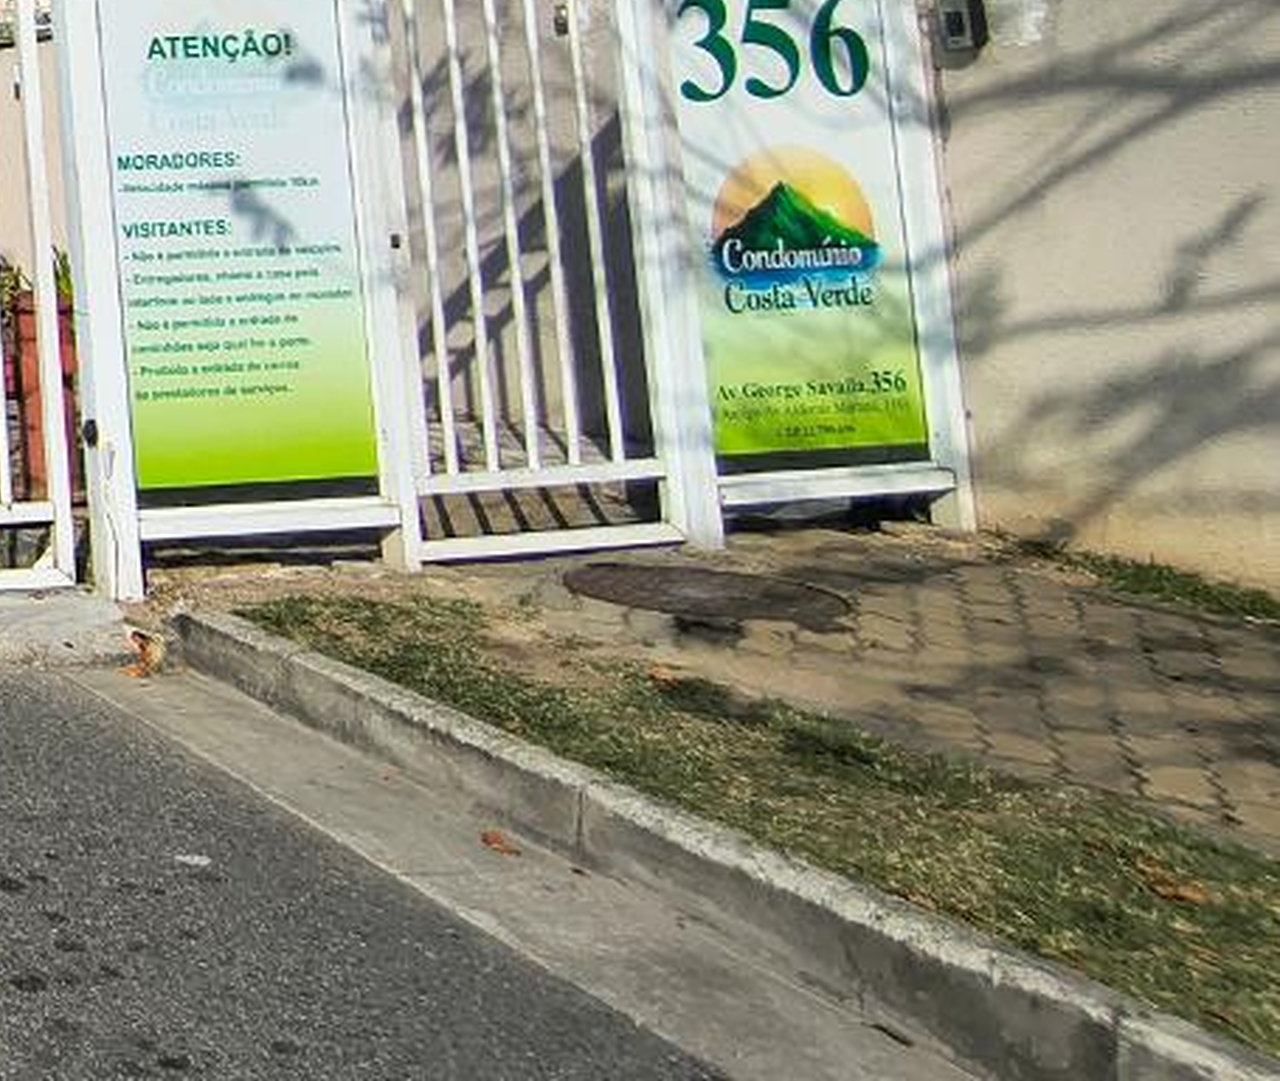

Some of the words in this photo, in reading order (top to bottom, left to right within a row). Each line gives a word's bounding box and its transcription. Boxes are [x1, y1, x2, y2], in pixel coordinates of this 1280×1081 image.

[148, 29, 292, 63] ATENÇÃO!
[117, 151, 240, 170] MORADORES:
[122, 220, 232, 238] VISITANTES:
[722, 235, 862, 272] Condomínio
[725, 278, 796, 314] Costa
[803, 274, 873, 309] Verde
[742, 382, 802, 400] George
